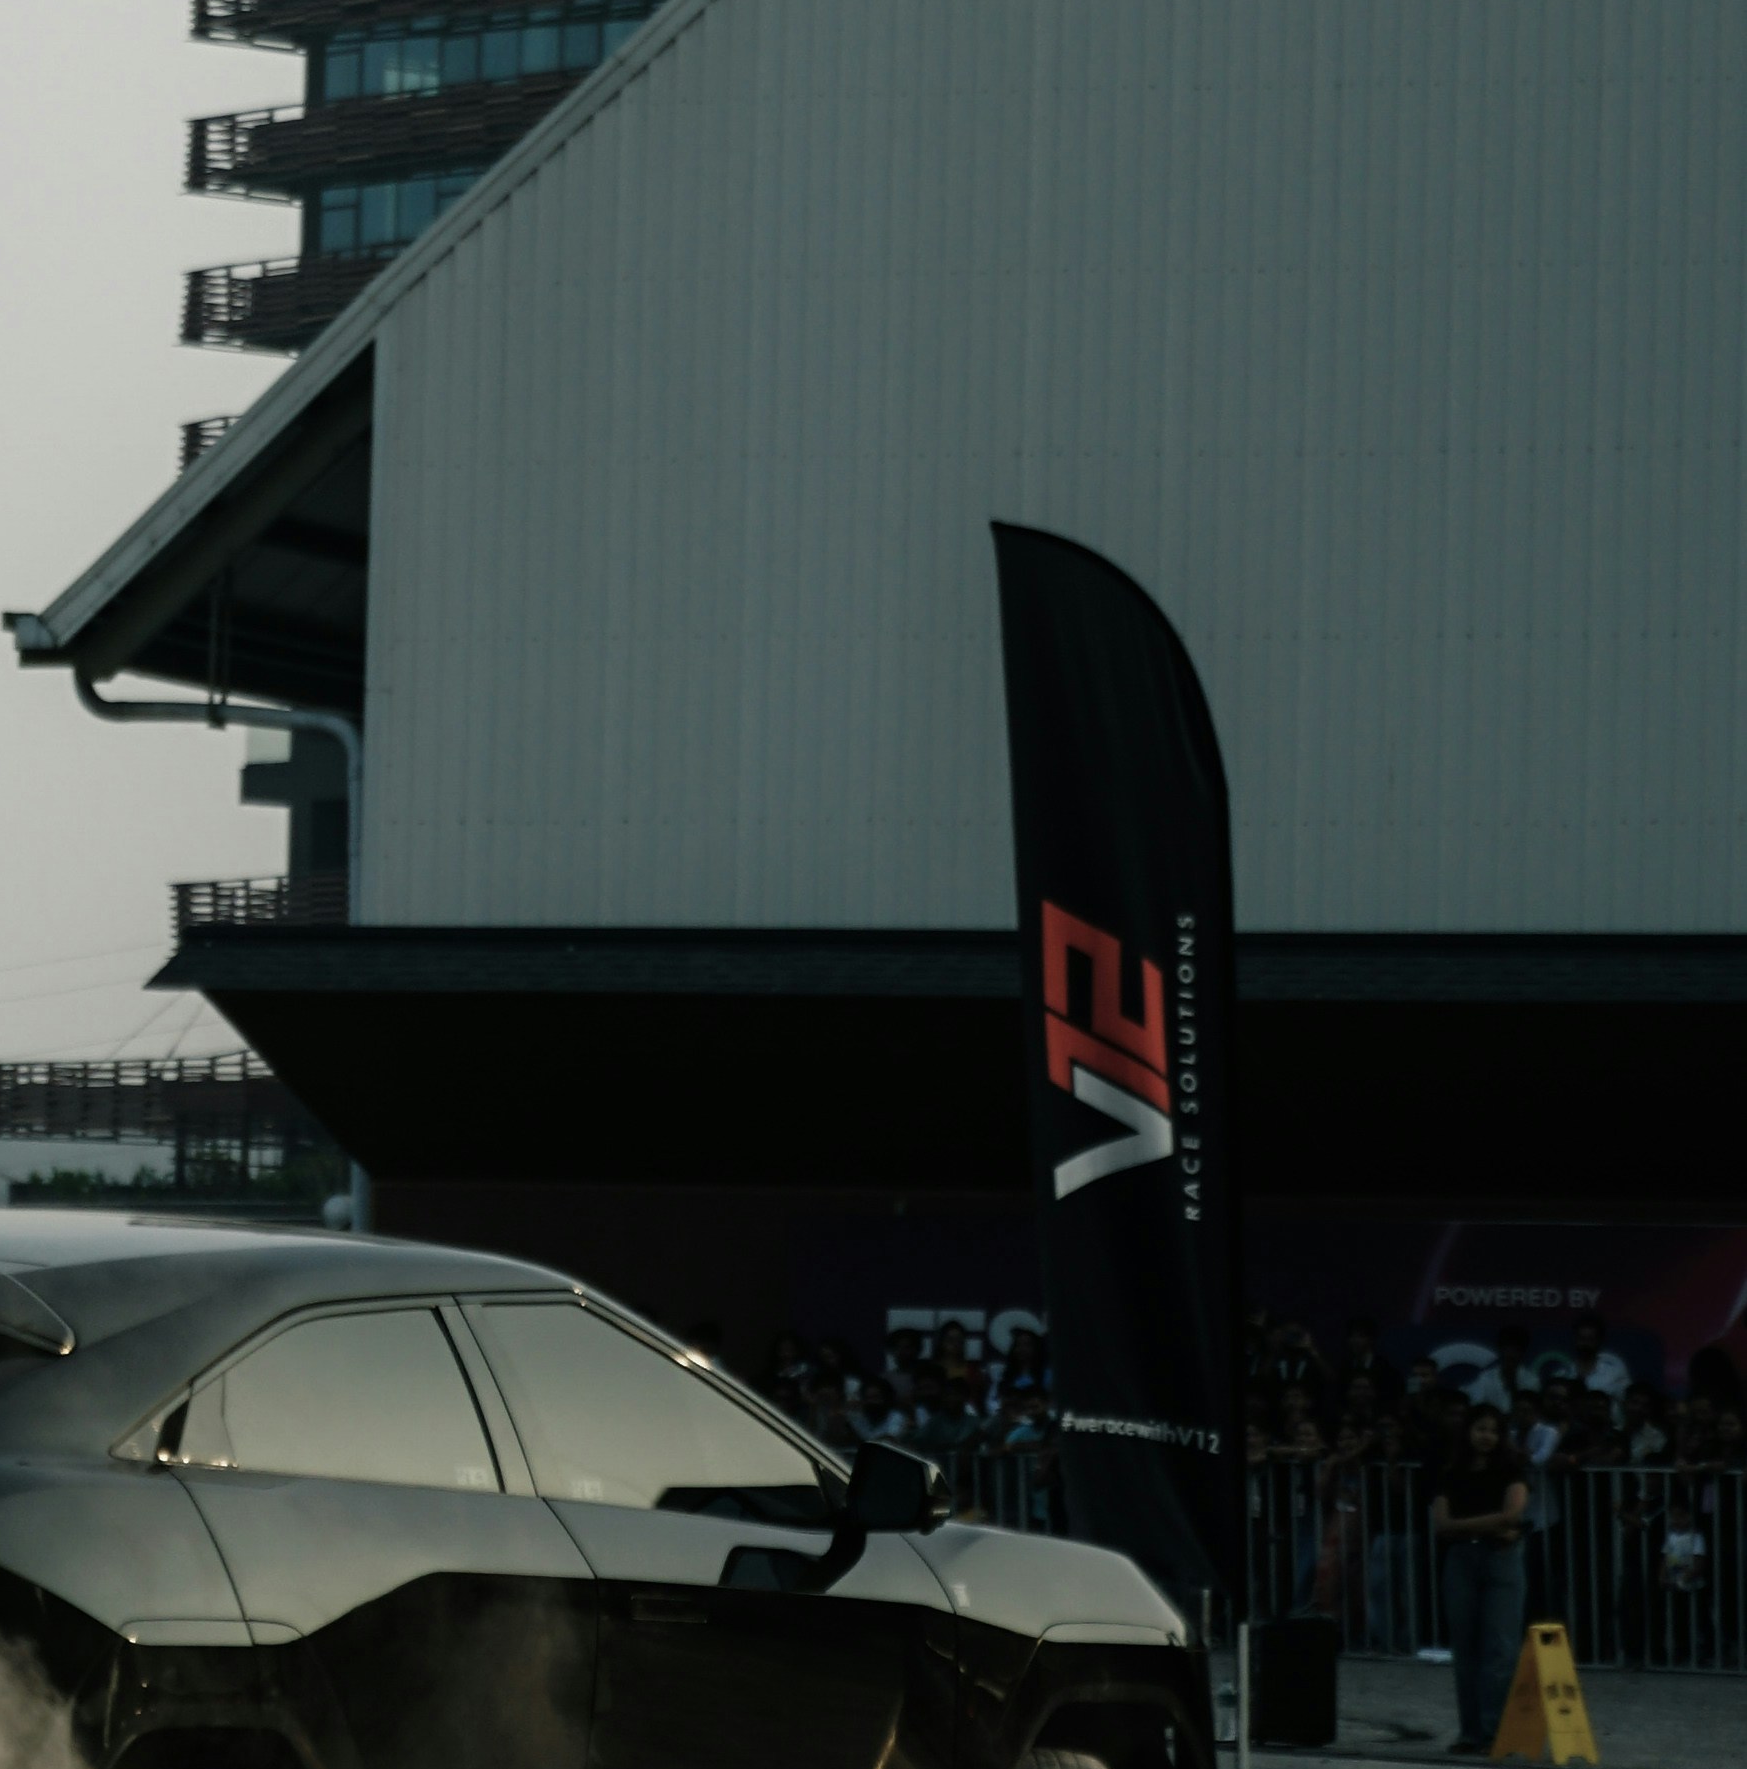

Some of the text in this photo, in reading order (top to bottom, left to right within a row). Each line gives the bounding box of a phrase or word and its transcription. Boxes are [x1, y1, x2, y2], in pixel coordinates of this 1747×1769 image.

[1041, 899, 1175, 1201] V12
[1175, 910, 1201, 1222] RACE SOLUTIONS
[1434, 1286, 1602, 1309] POWERED BY
[1061, 1411, 1222, 1455] #weracewithV12
